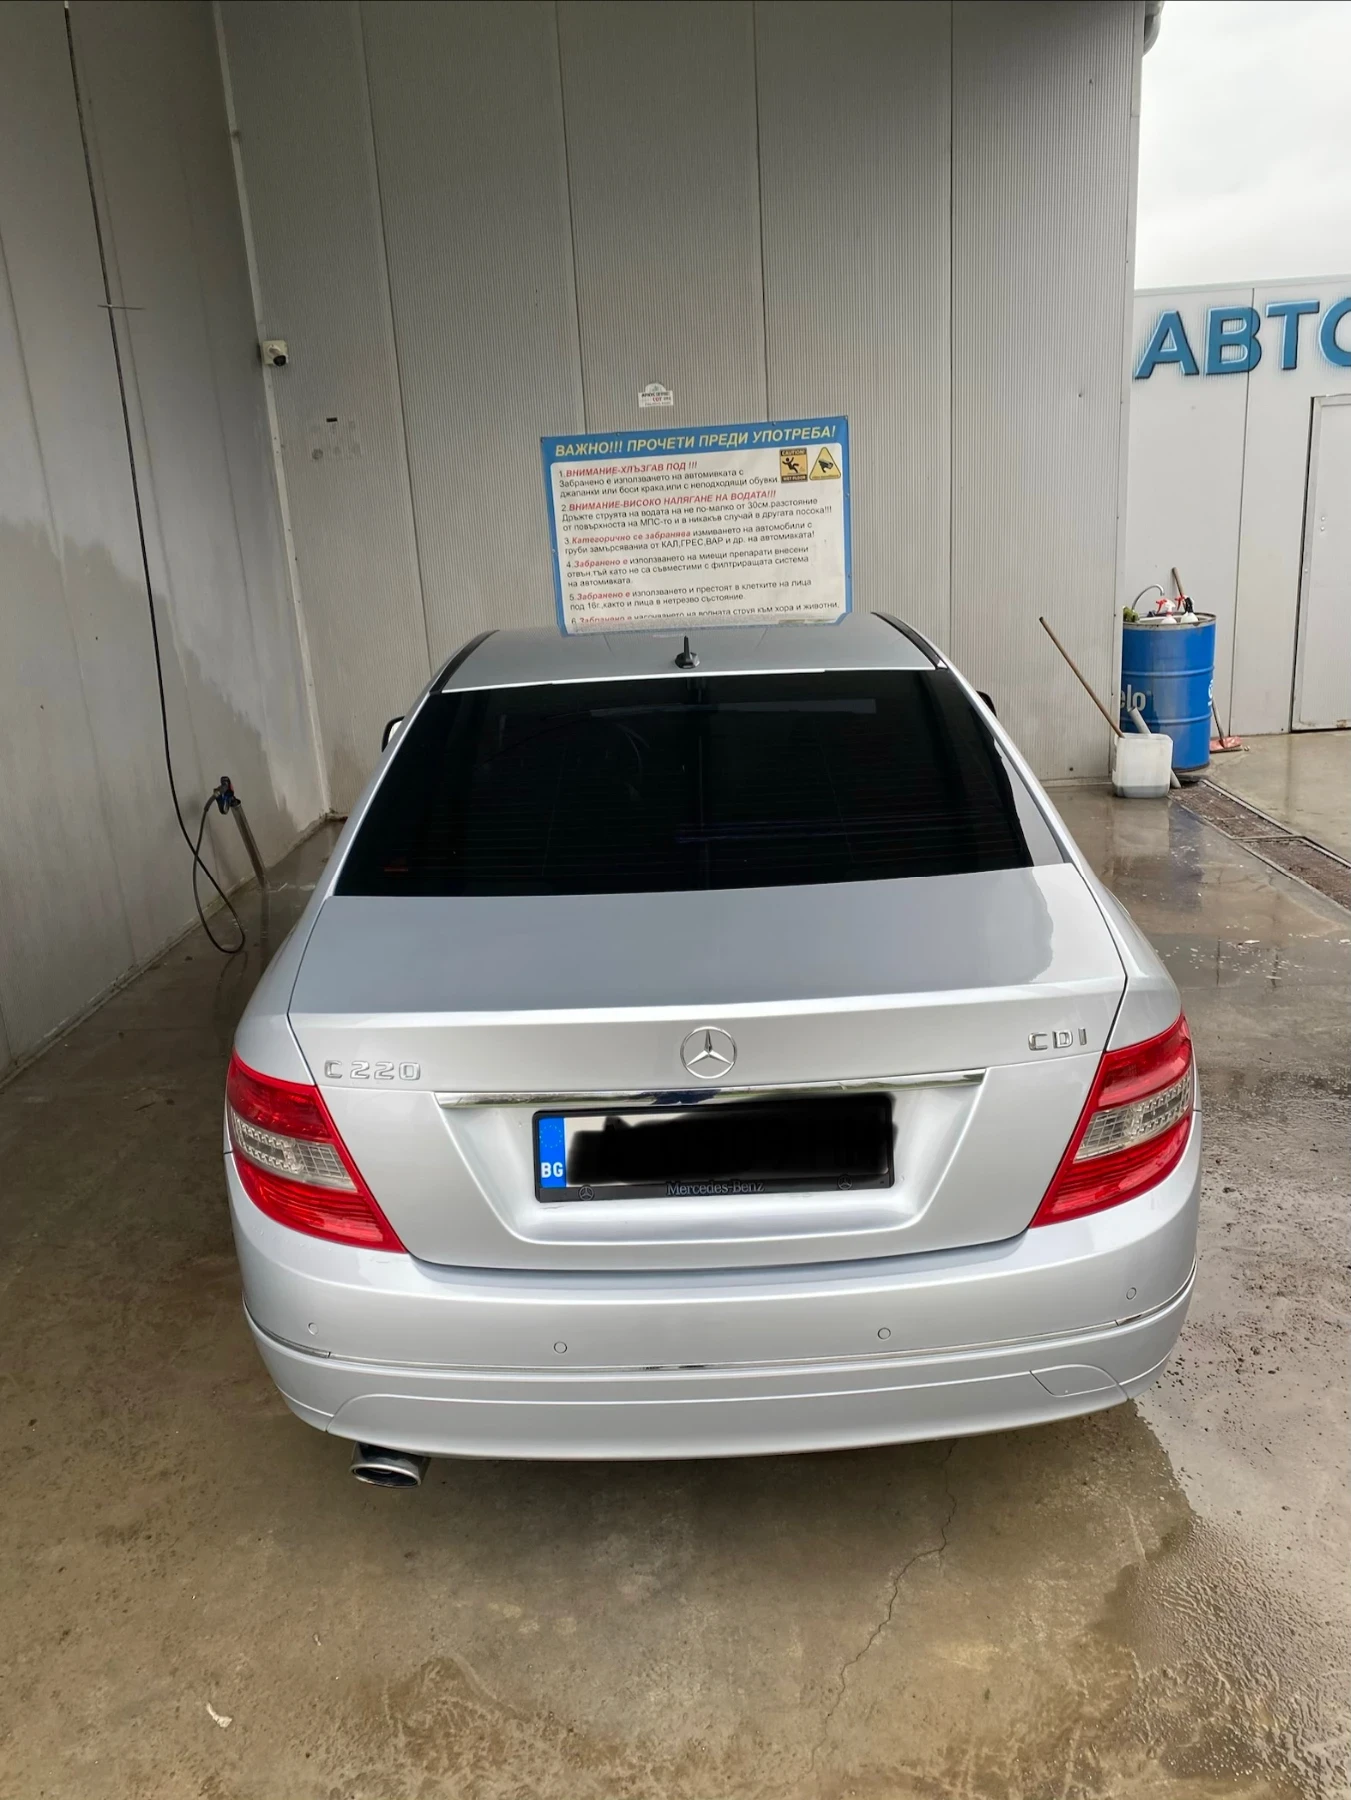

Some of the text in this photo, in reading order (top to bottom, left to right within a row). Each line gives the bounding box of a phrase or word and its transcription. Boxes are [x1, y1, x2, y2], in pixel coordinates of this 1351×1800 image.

[555, 425, 836, 457] ВАЖНО!!! ПРОЧЕТИ ПРЕДИ УПОТРЕБА!
[667, 463, 686, 471] ПОД
[559, 479, 604, 488] Забранено
[614, 475, 669, 484] използването
[685, 470, 736, 479] автомивката
[560, 490, 600, 498] джапанки
[691, 479, 747, 488] неподходящи
[664, 495, 713, 505] НАЛЯГАНЕ
[731, 490, 776, 501] ВОДАТА!!!
[562, 513, 593, 522] Дръжте
[596, 512, 627, 520] струята
[641, 509, 669, 517] водата
[697, 504, 734, 513] по-малко
[574, 522, 625, 531] повърхноста
[640, 518, 671, 526] МПС-то
[689, 513, 721, 522] никакъв
[724, 512, 753, 522] случай
[762, 510, 793, 520] другата
[796, 506, 832, 515] посока!!!
[645, 530, 690, 540] забранява
[693, 527, 741, 536] измиването
[756, 522, 805, 532] автомобили
[565, 546, 587, 555] груби
[760, 531, 815, 542] автомивката!
[630, 556, 684, 564] използването
[700, 552, 727, 560] миещи
[729, 549, 773, 559] препарати
[775, 546, 808, 555] внесени
[653, 563, 702, 572] съвместими
[711, 559, 773, 569] филтриращата
[775, 556, 809, 564] система
[633, 588, 687, 597] използването
[697, 584, 732, 593] престоят
[742, 581, 777, 590] клетките
[792, 579, 812, 587] лица
[571, 603, 584, 611] под
[634, 598, 653, 607] лица
[663, 596, 699, 605] нетрезво
[758, 605, 773, 613] към
[775, 604, 794, 613] хора
[1028, 1028, 1087, 1051] CDI
[324, 1059, 420, 1081] C 220
[541, 1162, 563, 1178] BG
[666, 1180, 764, 1196] Mercedes-Benz
